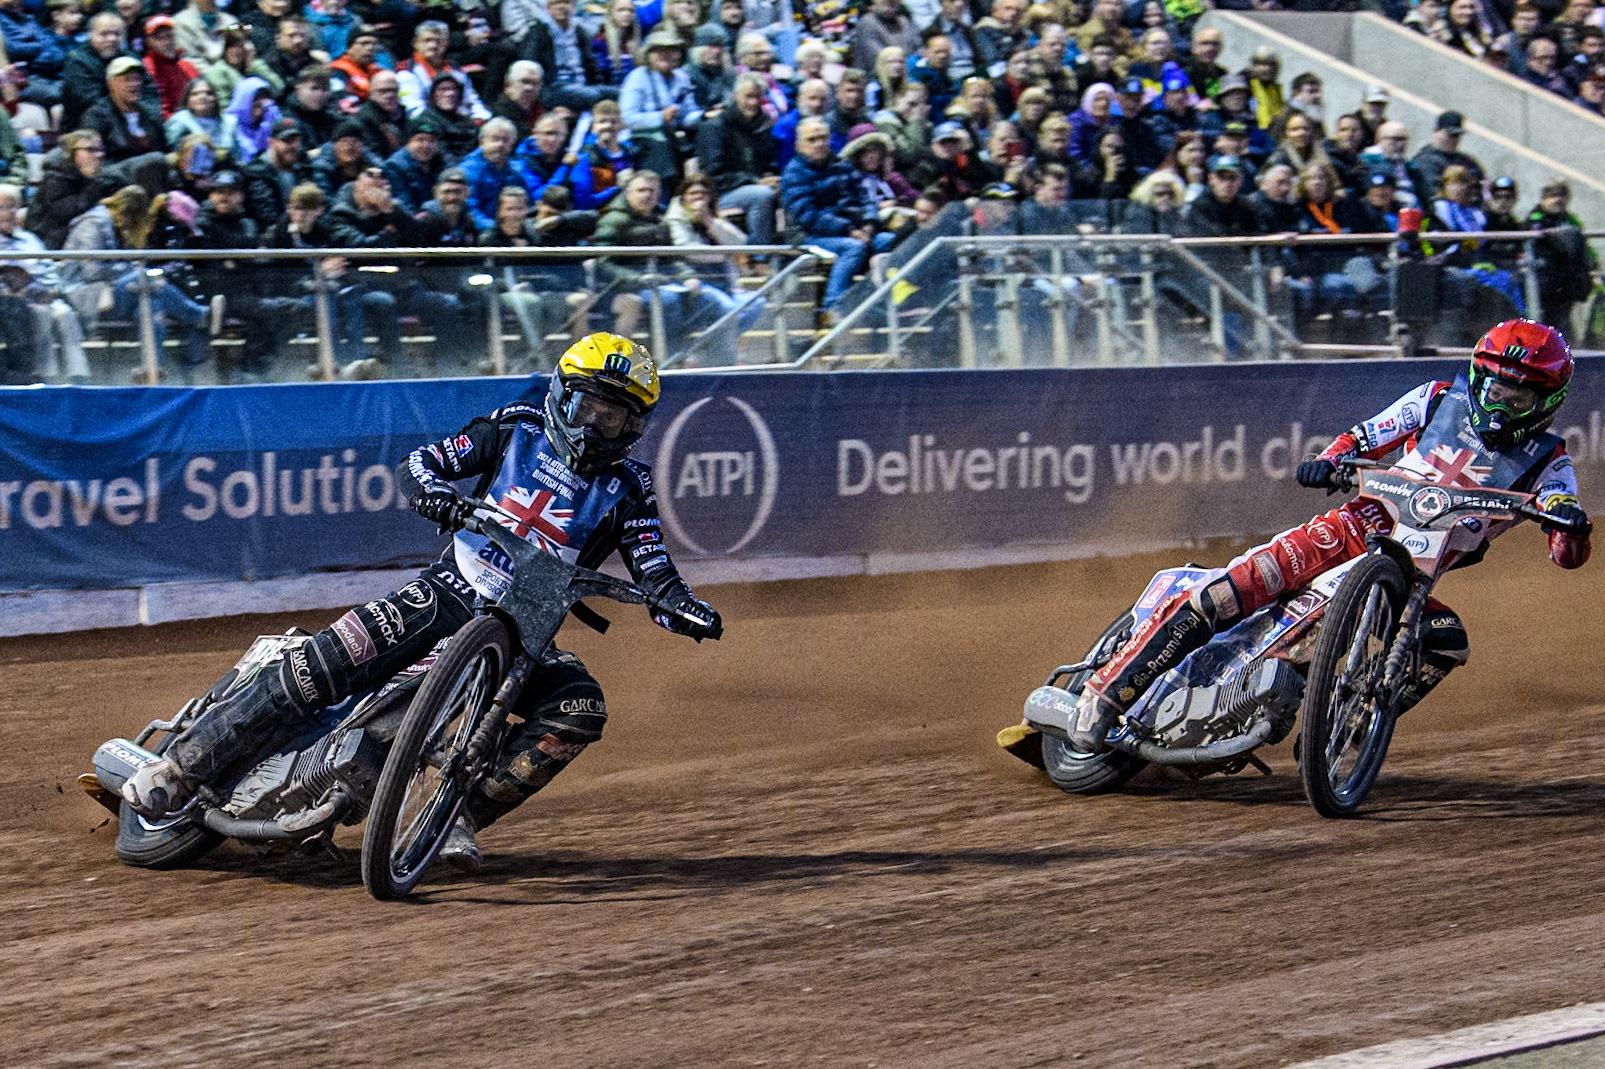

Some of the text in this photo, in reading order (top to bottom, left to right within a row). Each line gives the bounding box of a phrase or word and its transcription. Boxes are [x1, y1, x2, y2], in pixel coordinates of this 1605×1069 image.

[539, 461, 561, 480] SPORTS
[837, 431, 1095, 503] Delivering
[1110, 424, 1246, 485] world
[182, 448, 412, 522] Solutio
[531, 468, 575, 501] BRITISH FINAL
[674, 451, 755, 499] ATPI
[606, 476, 622, 495] 8
[1315, 526, 1333, 544] ATPI
[1405, 539, 1425, 550] ATPI
[481, 569, 510, 590] SPORTS
[405, 585, 427, 602] ATPI
